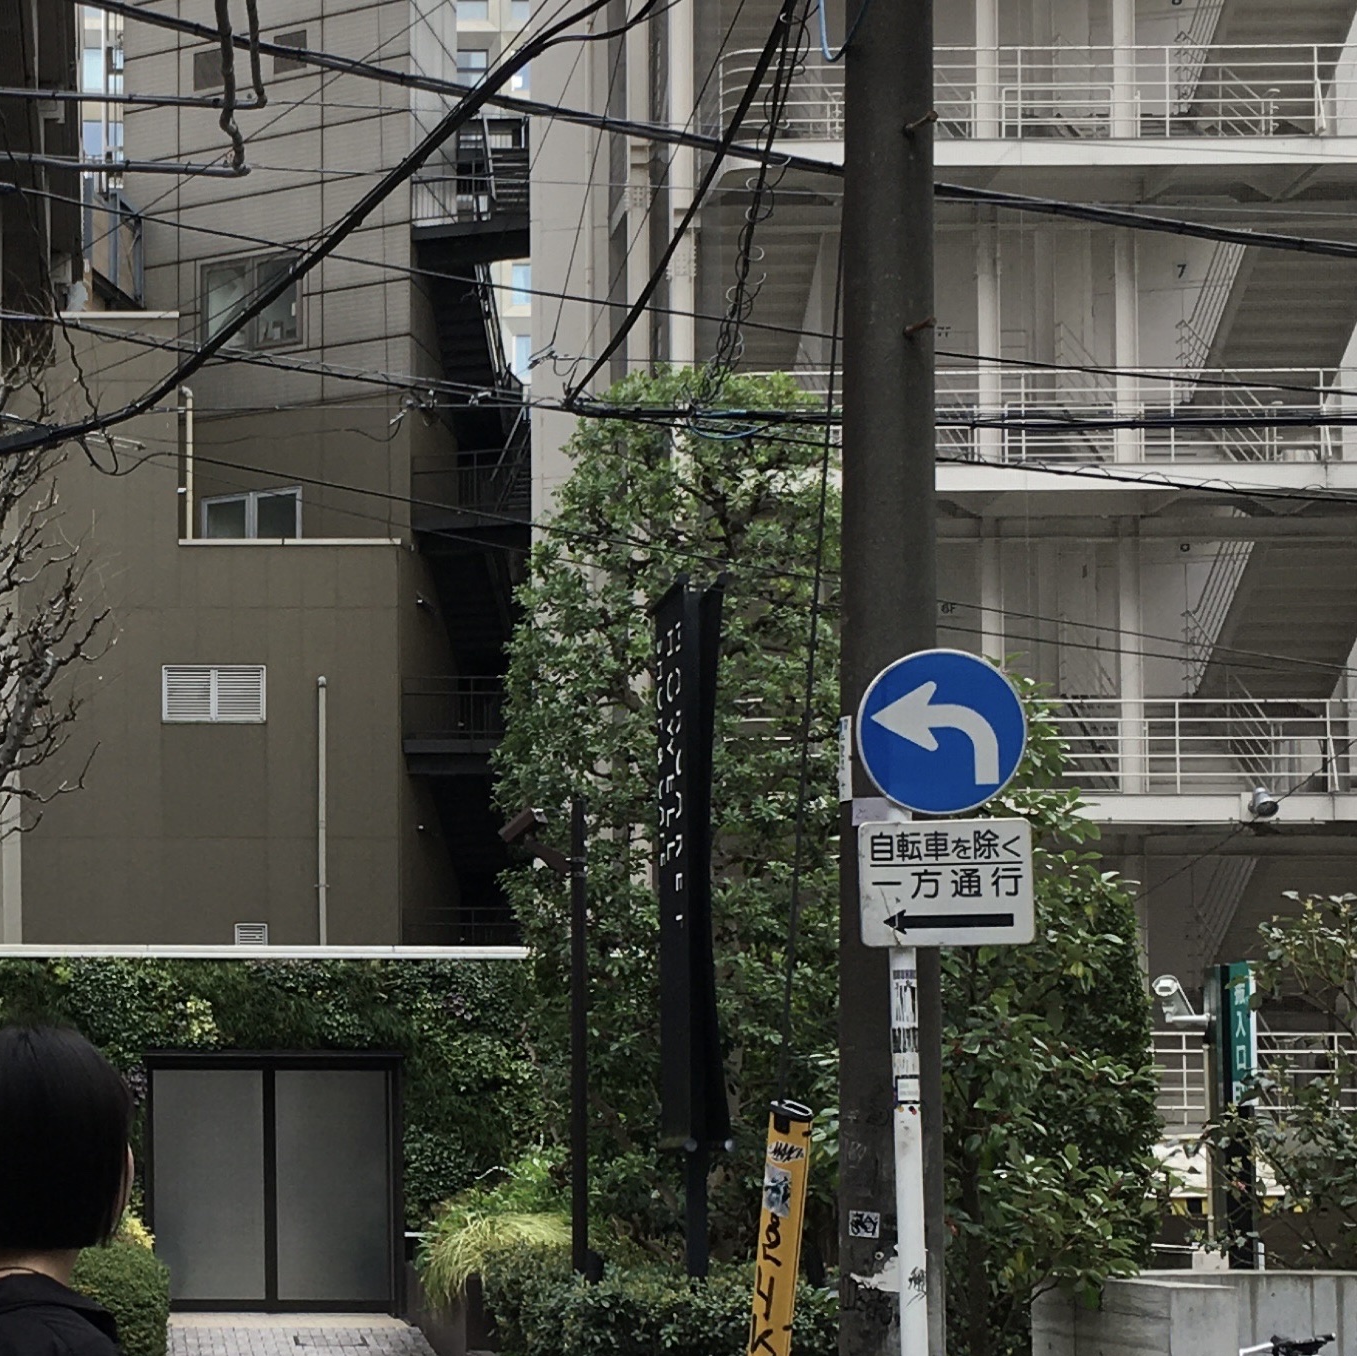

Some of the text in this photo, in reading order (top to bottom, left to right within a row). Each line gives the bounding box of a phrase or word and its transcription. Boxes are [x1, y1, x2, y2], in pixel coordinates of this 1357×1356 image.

[1177, 264, 1186, 279] 7
[666, 627, 676, 863] HOWELL
[870, 830, 1021, 862] 自転車を除く
[871, 867, 1023, 899] 一方通行
